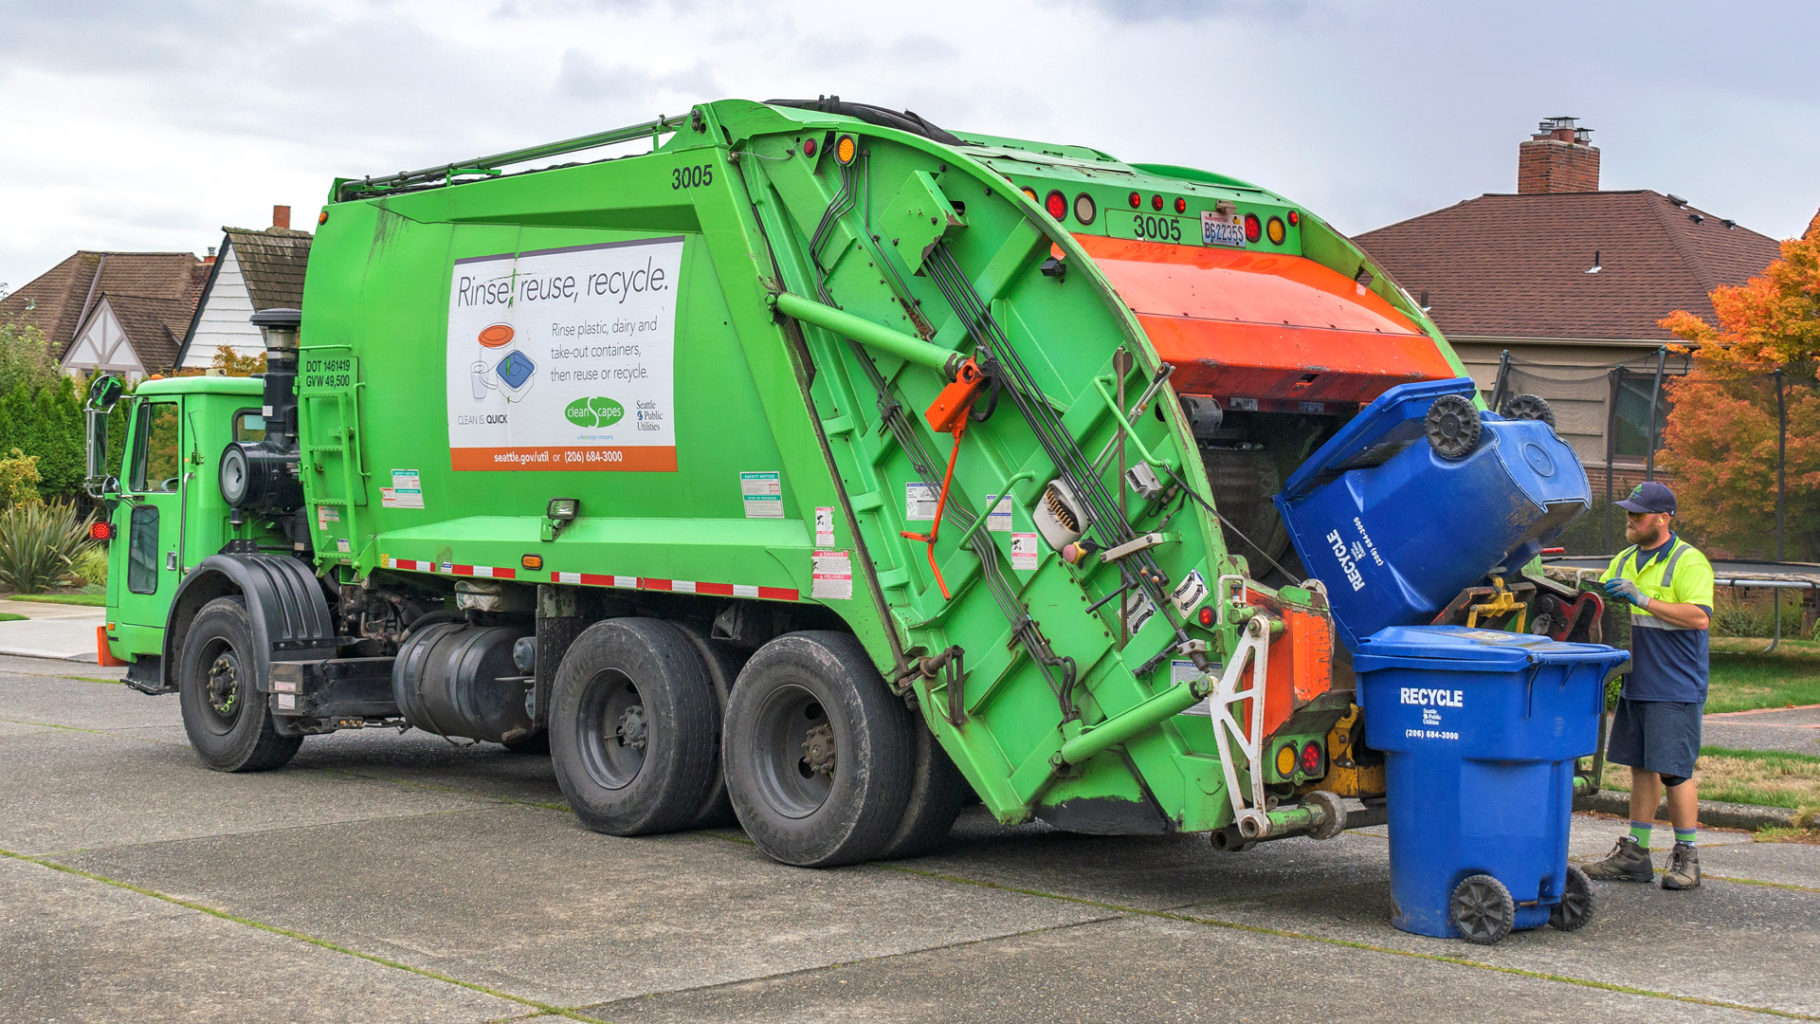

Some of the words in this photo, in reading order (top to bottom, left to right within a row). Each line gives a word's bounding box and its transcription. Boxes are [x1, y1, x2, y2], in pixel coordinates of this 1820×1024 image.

[672, 164, 712, 190] 3005
[1133, 214, 1181, 242] 3005
[1204, 221, 1244, 242] B62235S
[458, 276, 512, 308] Rinse,
[520, 275, 579, 303] reuse,
[587, 256, 669, 304] recycle.
[551, 322, 575, 337] Rinse
[577, 320, 609, 339] plastic,
[612, 318, 636, 336] dairy
[638, 315, 658, 332] and
[551, 344, 589, 360] take-out
[591, 342, 642, 357] containers,
[306, 360, 322, 372] DOT
[323, 359, 350, 372] 1461419
[550, 367, 571, 382] then
[573, 369, 599, 381] reuse
[601, 369, 611, 380] or
[613, 363, 649, 383] recycle.
[306, 375, 324, 387] GVW
[325, 375, 350, 389] 49,500
[636, 400, 656, 410] Seattle
[457, 415, 477, 425] CLEAN
[486, 414, 508, 424] QUICK
[644, 411, 663, 420] Public
[637, 421, 660, 431] Utilities
[494, 450, 549, 465] seattle.gov/util
[552, 453, 560, 462] or
[564, 450, 584, 463] (206)
[586, 450, 623, 462] 684-3000
[1353, 516, 1373, 549] 684-3000
[1326, 529, 1366, 592] RECYCLE
[1370, 547, 1384, 567] (206)
[1400, 687, 1463, 707] RECYCLE
[1405, 729, 1424, 739] (206)
[1426, 730, 1459, 740] 684-3000
